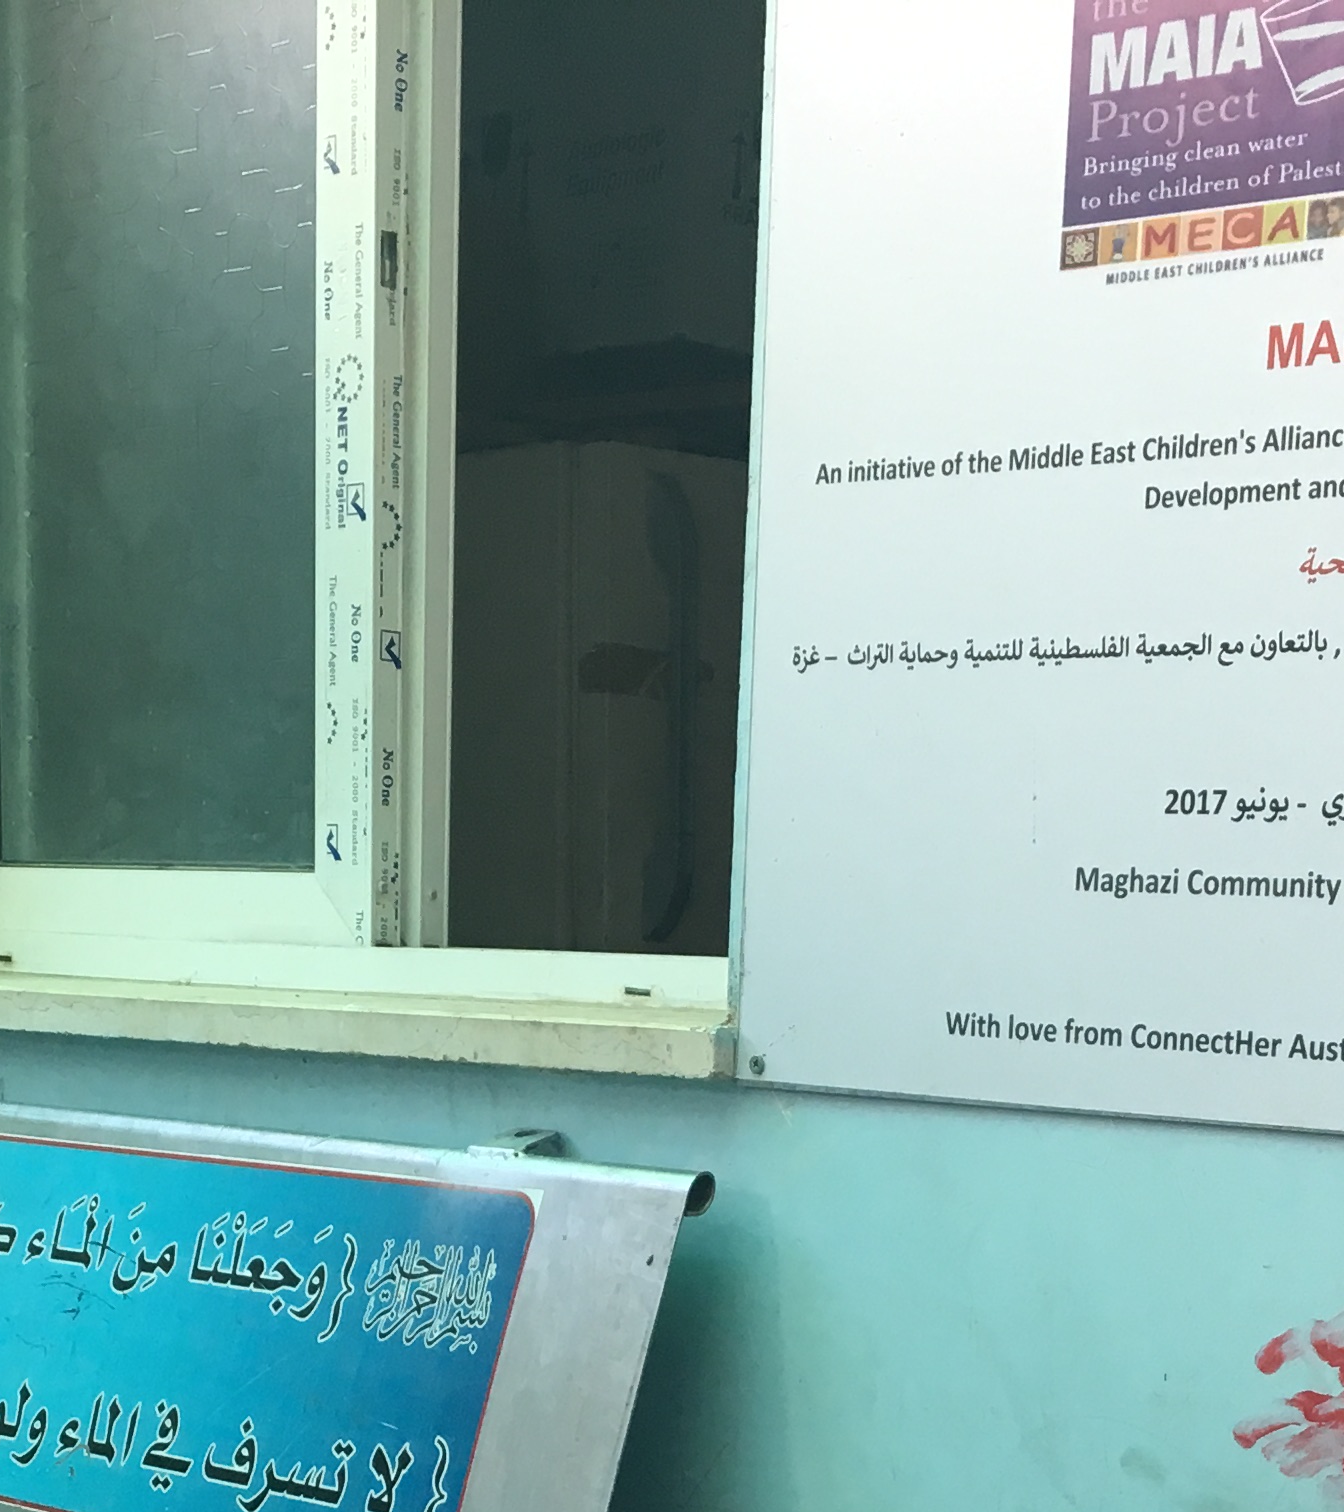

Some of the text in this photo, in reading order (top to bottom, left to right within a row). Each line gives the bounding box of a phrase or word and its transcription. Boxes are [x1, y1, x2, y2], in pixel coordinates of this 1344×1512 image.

[1088, 7, 1264, 96] MAIA
[393, 48, 409, 113] No One
[1086, 87, 1261, 147] Project
[1083, 130, 1310, 178] Bringing clean water
[1081, 190, 1103, 211] to
[1108, 184, 1142, 207] the
[1148, 175, 1240, 203] children
[1247, 165, 1275, 190] of
[1142, 204, 1302, 258] MECA
[353, 222, 365, 340] The General Agent
[1105, 247, 1326, 286] MIDDLE EAST CHILDREN'S ALLIANCE
[391, 374, 403, 491] The General Agent
[815, 461, 844, 486] An
[846, 454, 937, 484] initiative
[941, 450, 964, 476] of
[968, 448, 1003, 473] the
[1008, 440, 1084, 471] Middle
[1090, 439, 1137, 464] East
[1141, 429, 1257, 463] Children's
[336, 460, 350, 530] Original
[1144, 477, 1303, 512] Development
[326, 574, 338, 687] The General Agent
[350, 603, 362, 664] No One
[962, 640, 1025, 668] للتنمية
[1028, 636, 1131, 668] الفلسطينية
[1134, 631, 1213, 661] الجمعية
[1250, 630, 1332, 669] بالتعاون
[792, 643, 822, 674] غزة
[846, 641, 895, 669] التراث
[896, 642, 960, 674] وحماية
[1217, 642, 1246, 669] مع
[381, 747, 394, 807] No One
[1164, 788, 1228, 816] 2017
[1230, 788, 1291, 824] يونيو
[350, 809, 360, 866] Standard
[1074, 865, 1179, 900] Maghazi
[1187, 869, 1342, 906] Community
[945, 1010, 1002, 1040] With
[1007, 1014, 1059, 1044] love
[1064, 1017, 1124, 1048] from
[1130, 1022, 1283, 1059] ConnectHer
[54, 1389, 143, 1468] الماء
[140, 1397, 194, 1493] في
